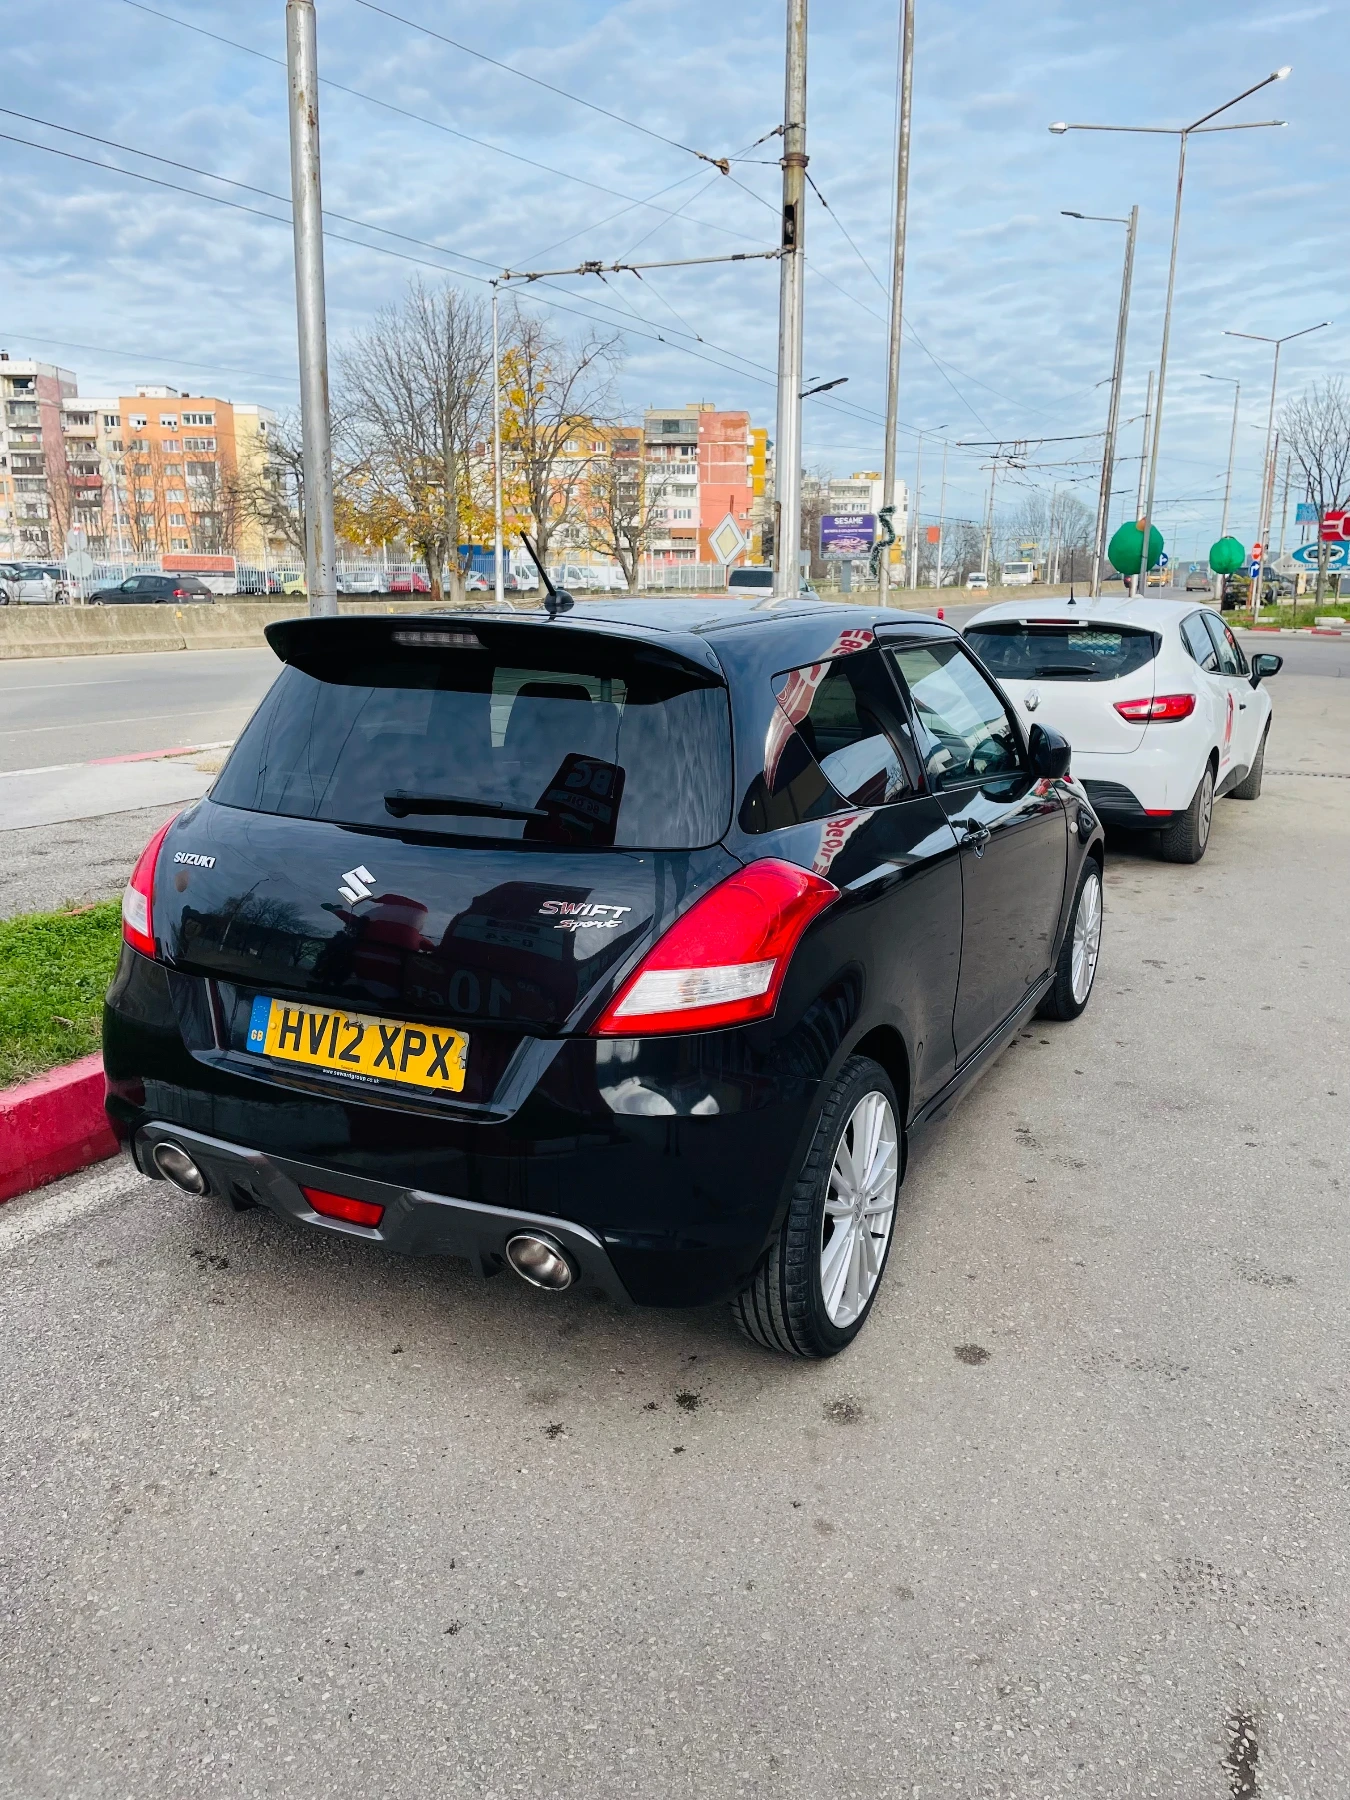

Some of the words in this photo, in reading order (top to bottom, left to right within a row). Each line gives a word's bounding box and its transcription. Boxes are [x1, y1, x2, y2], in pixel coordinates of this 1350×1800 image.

[173, 851, 216, 869] SUZUKI
[539, 900, 632, 919] SWIFT
[553, 919, 623, 932] Sport
[250, 1029, 264, 1042] GB
[278, 1007, 365, 1063] HV12
[373, 1024, 455, 1081] XPX
